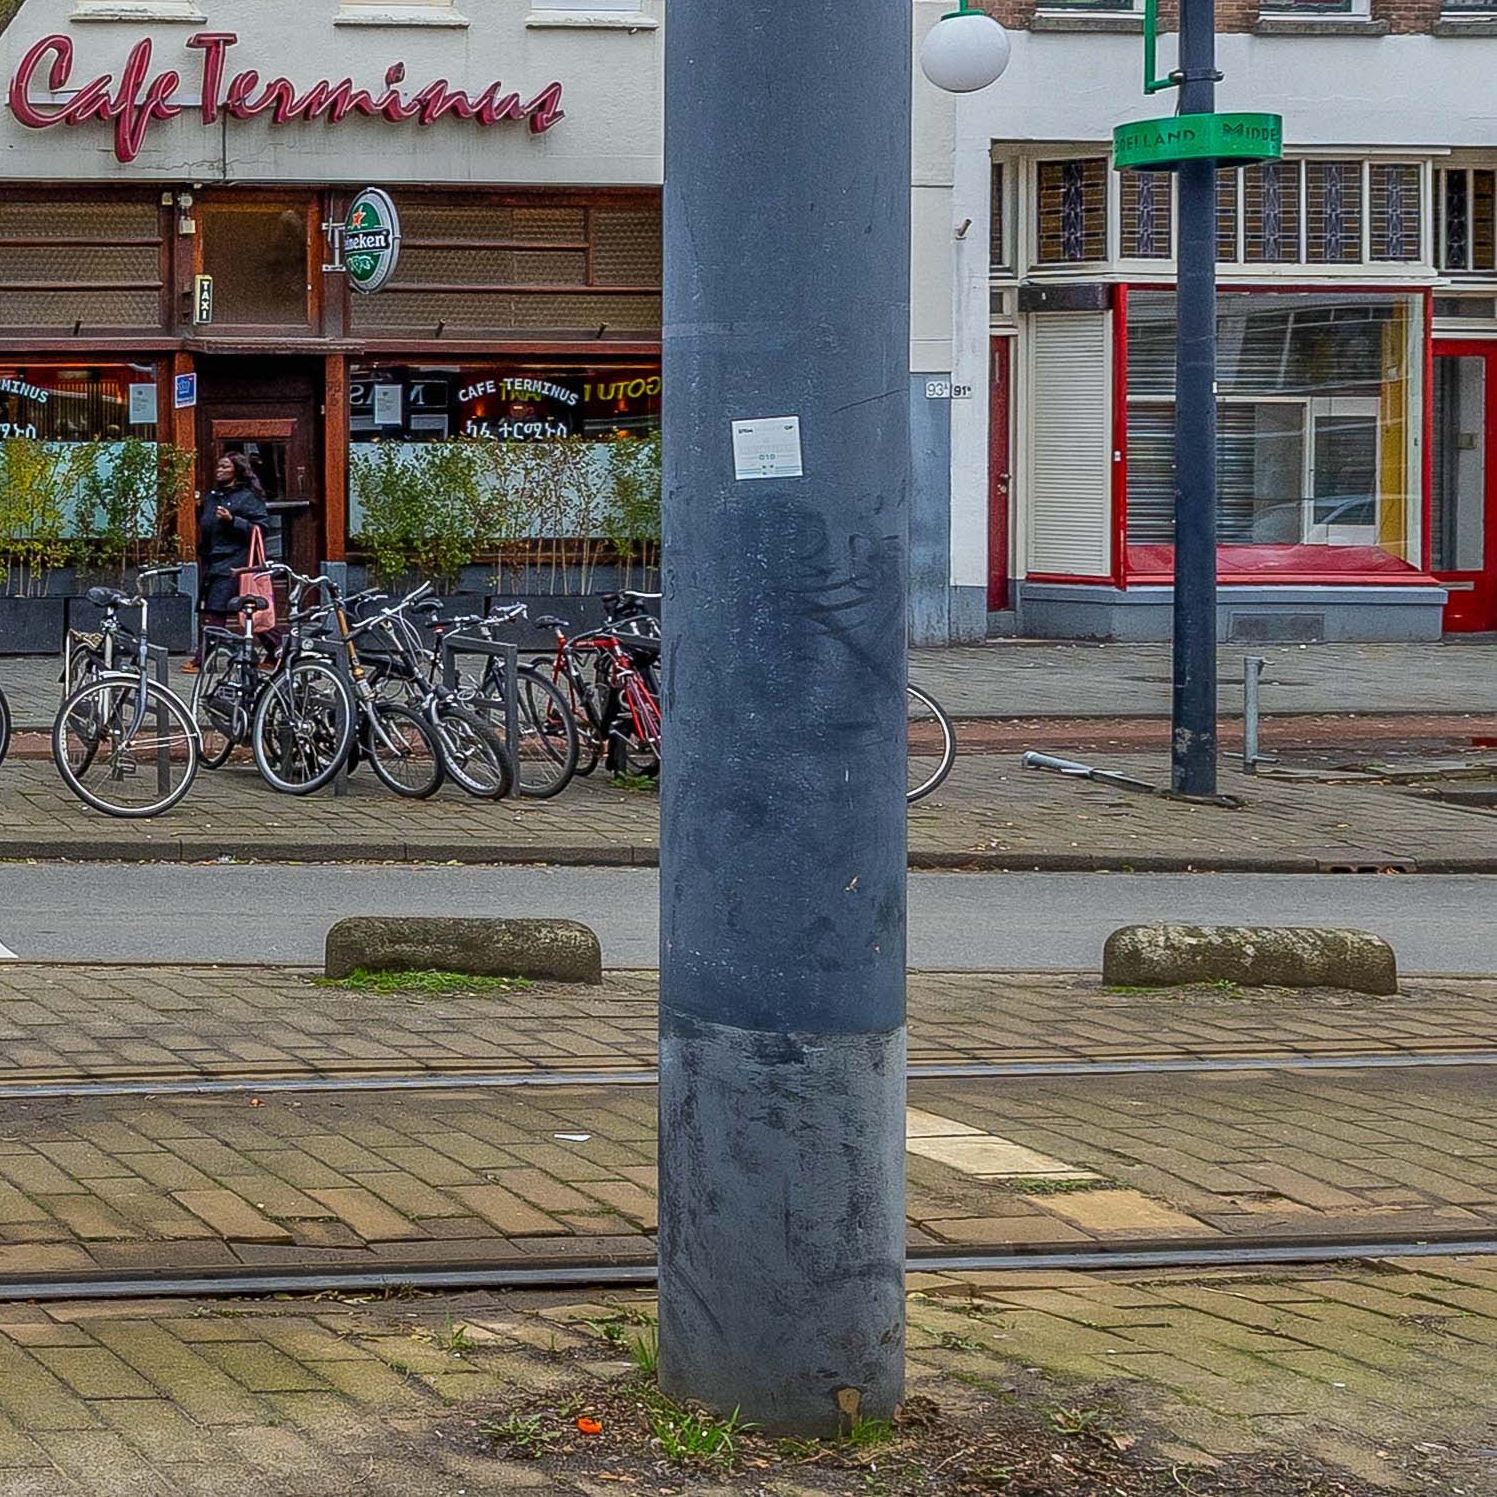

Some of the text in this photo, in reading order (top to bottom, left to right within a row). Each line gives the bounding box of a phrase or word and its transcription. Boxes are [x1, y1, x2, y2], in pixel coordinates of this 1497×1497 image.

[8, 32, 566, 163] Cafe Terminus
[201, 280, 210, 320] TAXI
[458, 380, 497, 402] CAFE
[503, 378, 579, 406] TERMINUS
